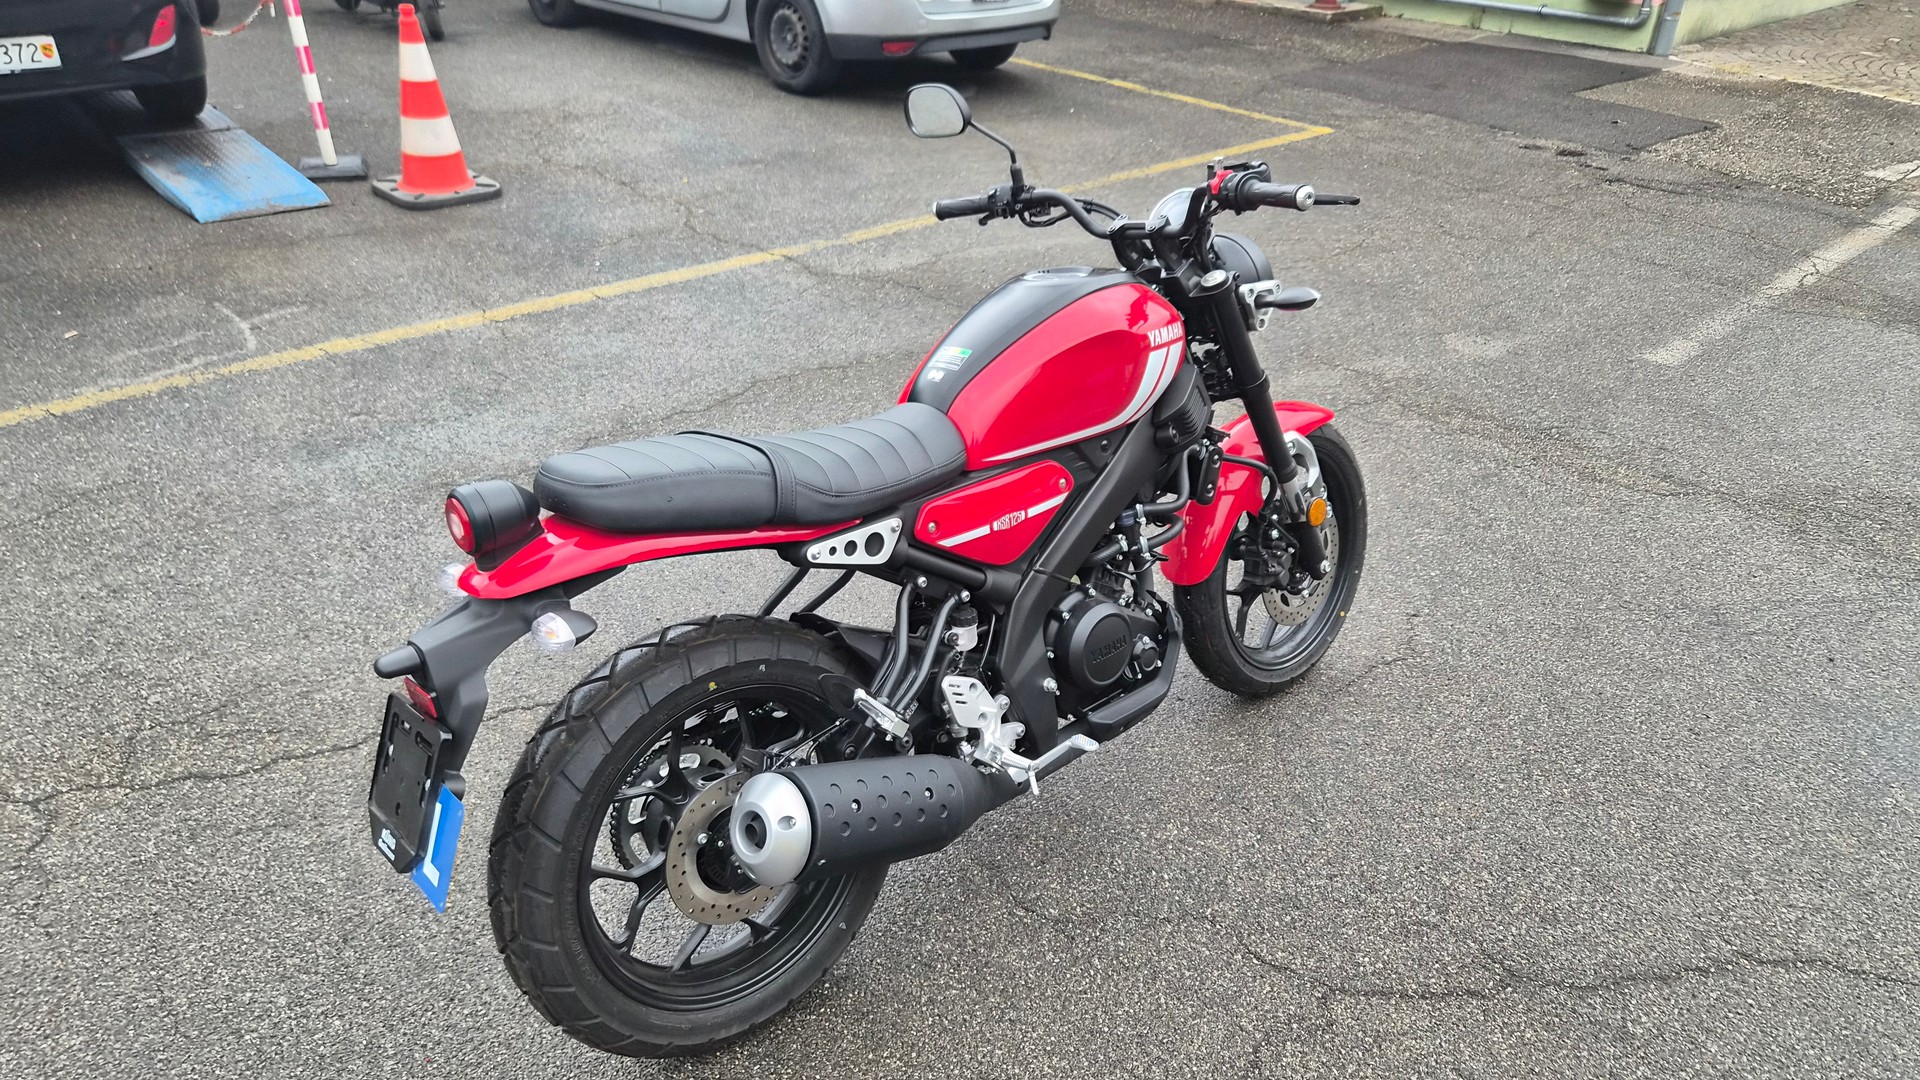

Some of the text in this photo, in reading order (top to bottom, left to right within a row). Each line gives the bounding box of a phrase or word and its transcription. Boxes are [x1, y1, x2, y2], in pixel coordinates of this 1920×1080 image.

[1147, 320, 1183, 347] YAMAHA
[1089, 634, 1128, 664] YAMAHA
[423, 802, 442, 888] L
